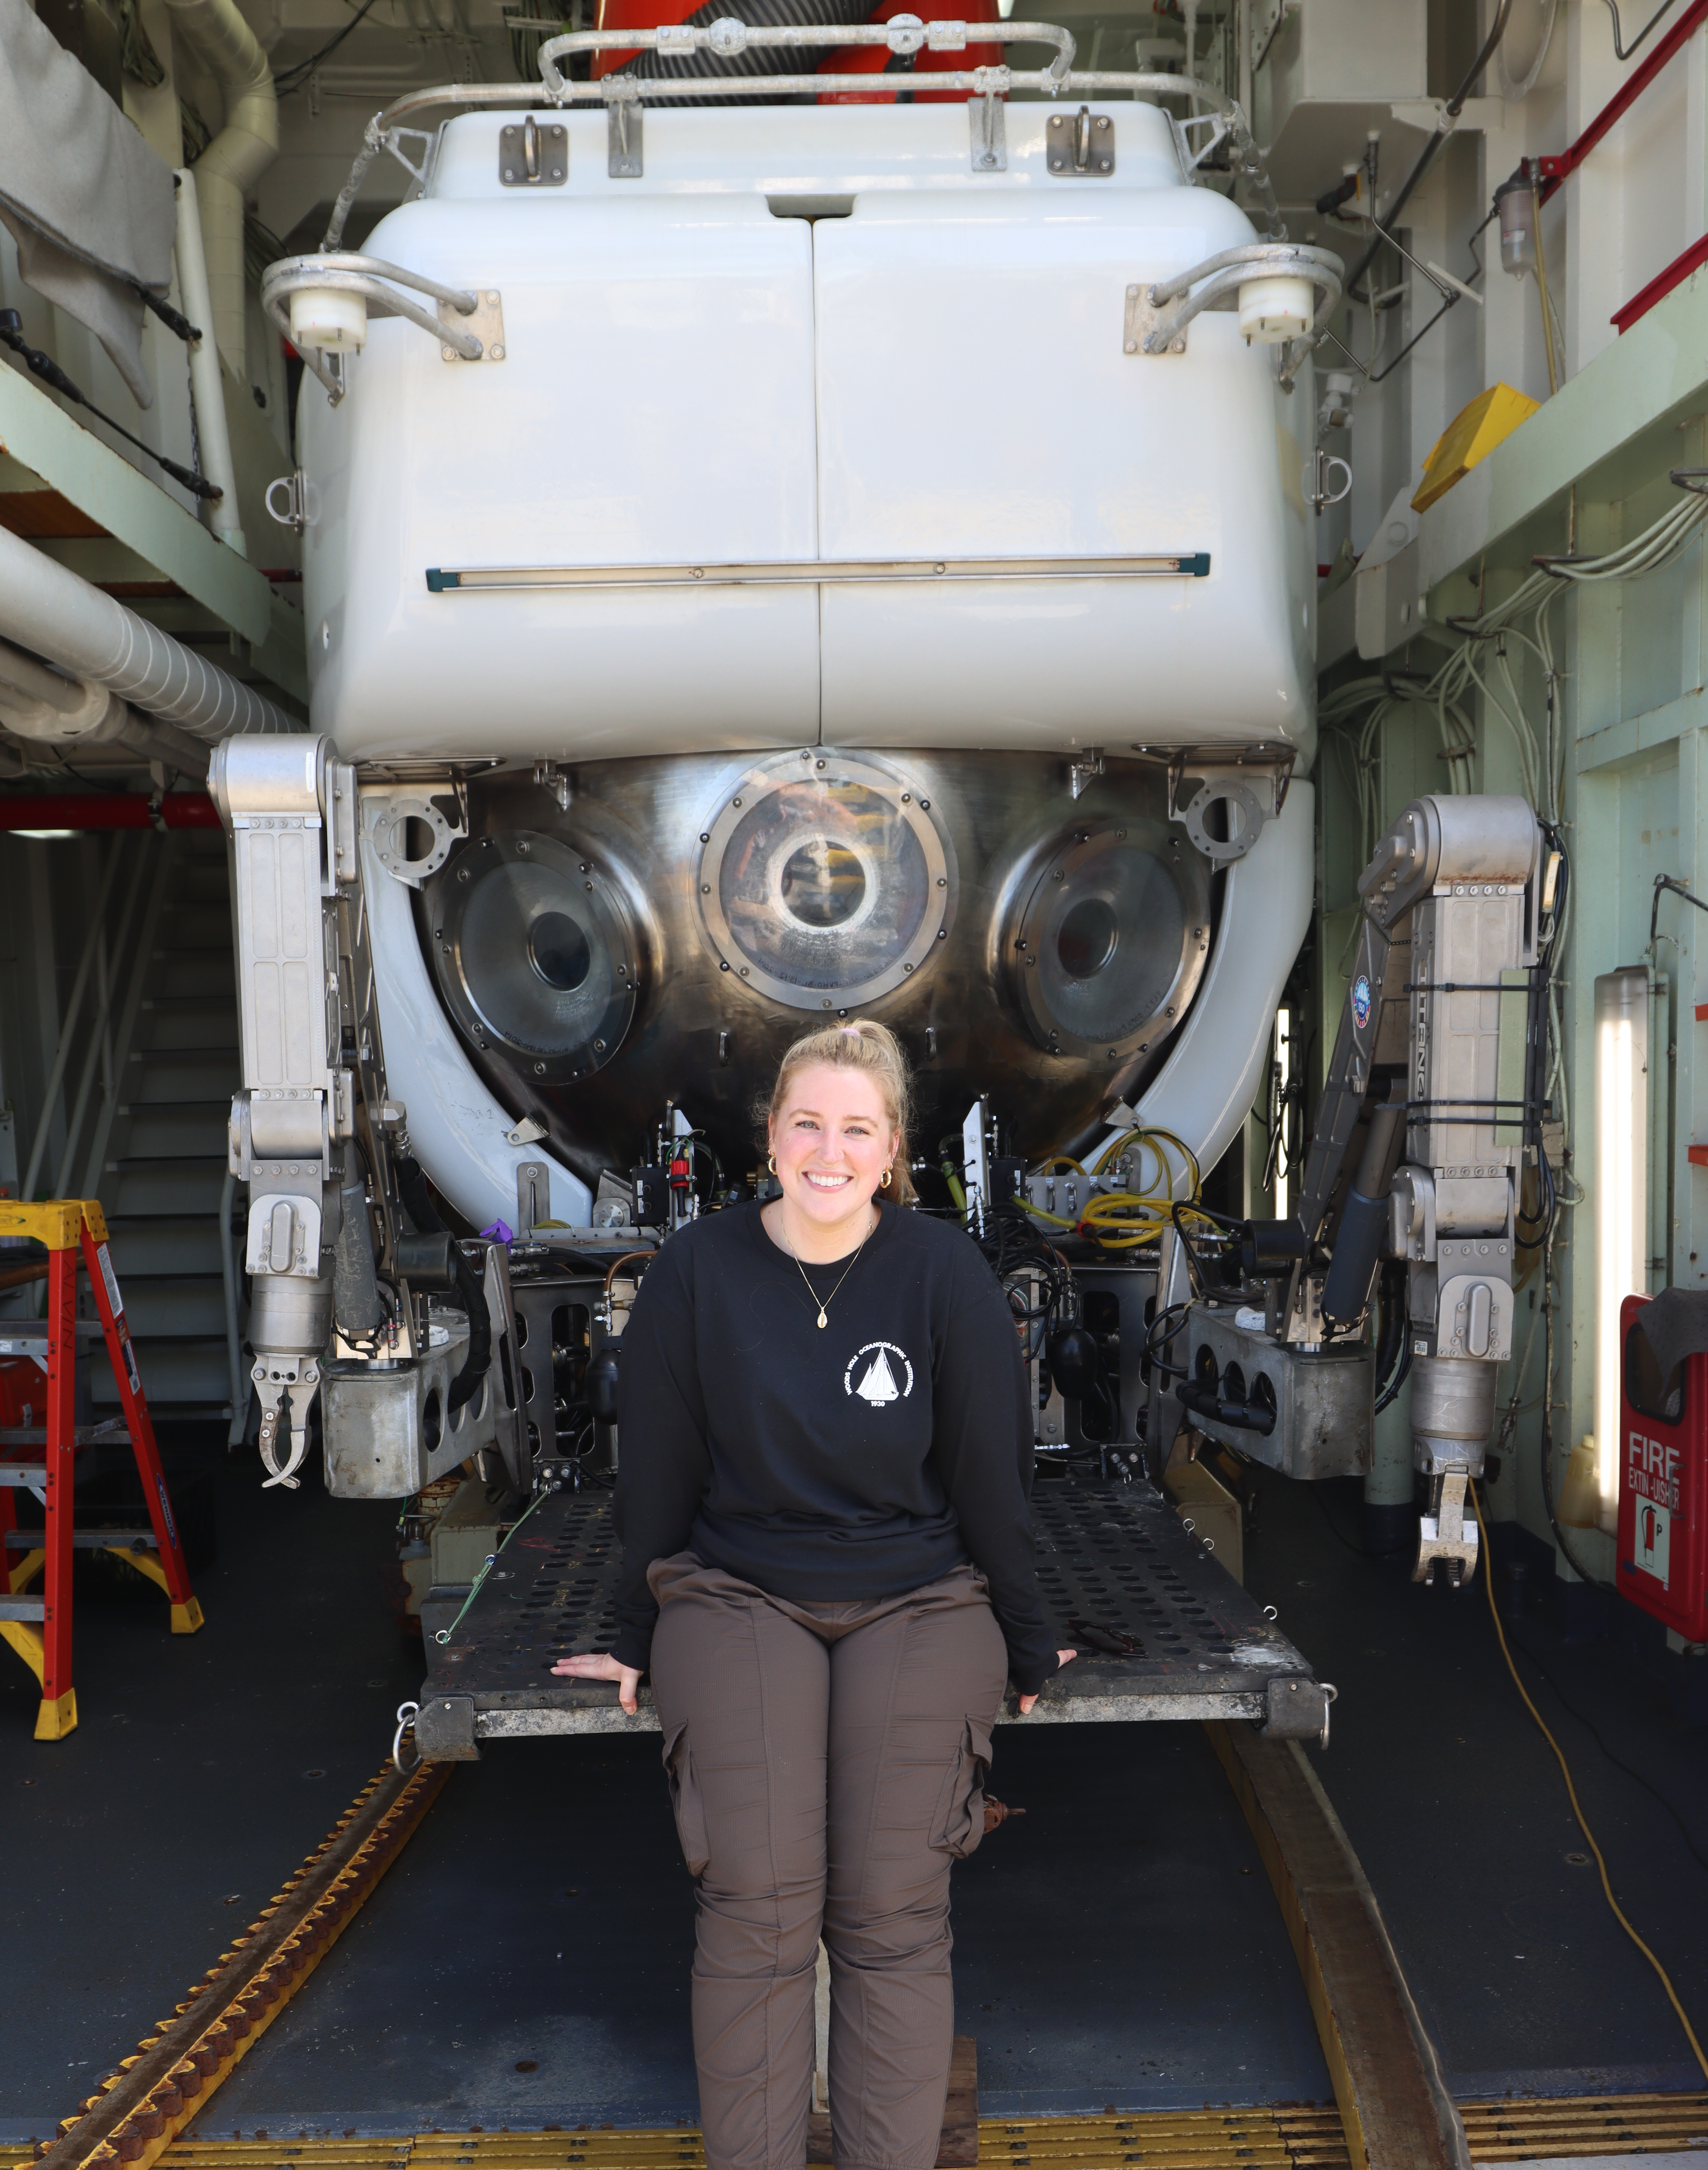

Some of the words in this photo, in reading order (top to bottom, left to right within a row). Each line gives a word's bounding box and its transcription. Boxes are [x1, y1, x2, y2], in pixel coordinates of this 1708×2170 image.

[63, 1259, 74, 1349] ALVIN
[847, 1355, 859, 1370] HOLE
[859, 1342, 907, 1360] OCEANOGRAPHIC
[844, 1372, 853, 1395] WOODS
[903, 1360, 914, 1397] INSTITUTION
[1630, 1431, 1680, 1485] FIRE
[1629, 1466, 1679, 1510] EXTINUISHR
[161, 1490, 174, 1533] WERNER
[1656, 1523, 1663, 1536] P
